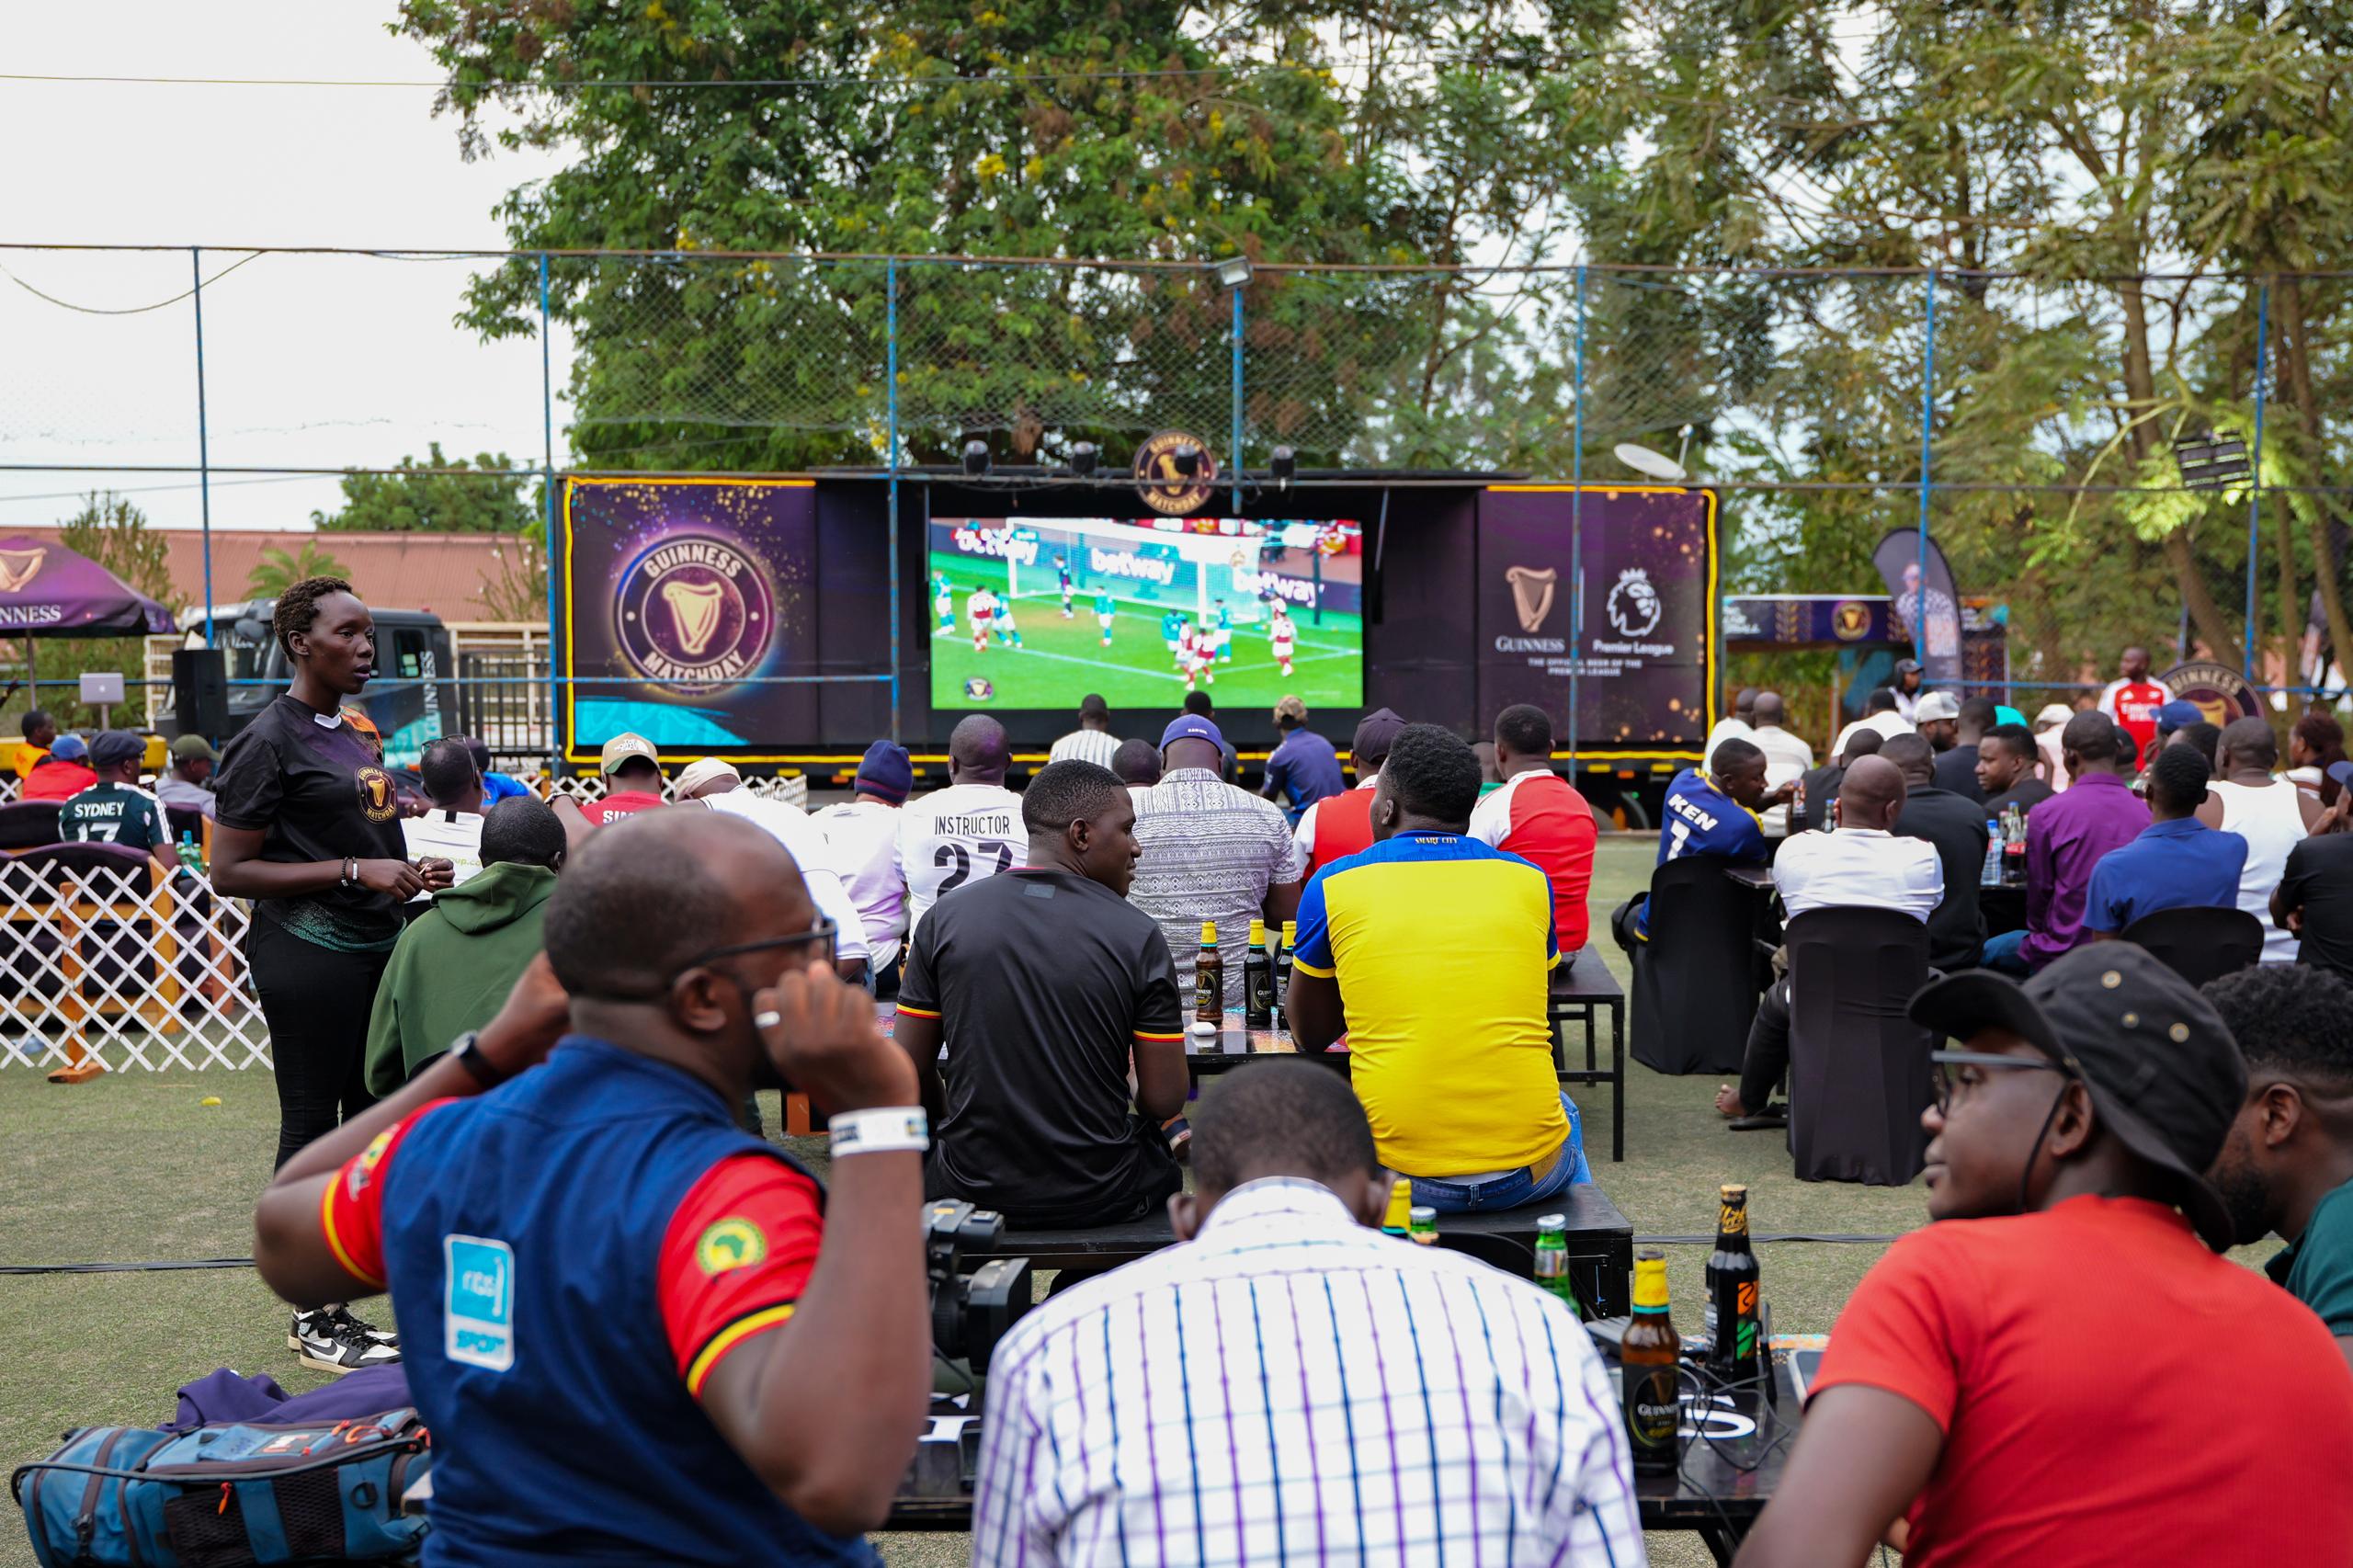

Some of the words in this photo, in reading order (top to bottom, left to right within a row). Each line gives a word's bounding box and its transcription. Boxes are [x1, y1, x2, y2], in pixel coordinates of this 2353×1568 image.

[644, 543, 742, 579] GUINNESS
[1091, 548, 1176, 585] betway
[1495, 635, 1565, 653] GUINNESS
[1592, 640, 1633, 654] Premier
[1633, 641, 1675, 657] League
[642, 650, 745, 685] MATCHDAY
[1546, 658, 1585, 668] OFFICL
[1548, 667, 1586, 676] PREMR
[2170, 669, 2243, 696] UINNESS
[74, 801, 125, 818] SYDNEY
[1667, 793, 1719, 832] KEN
[935, 815, 1010, 835] INSTRUCTOR
[934, 842, 1014, 899] 27
